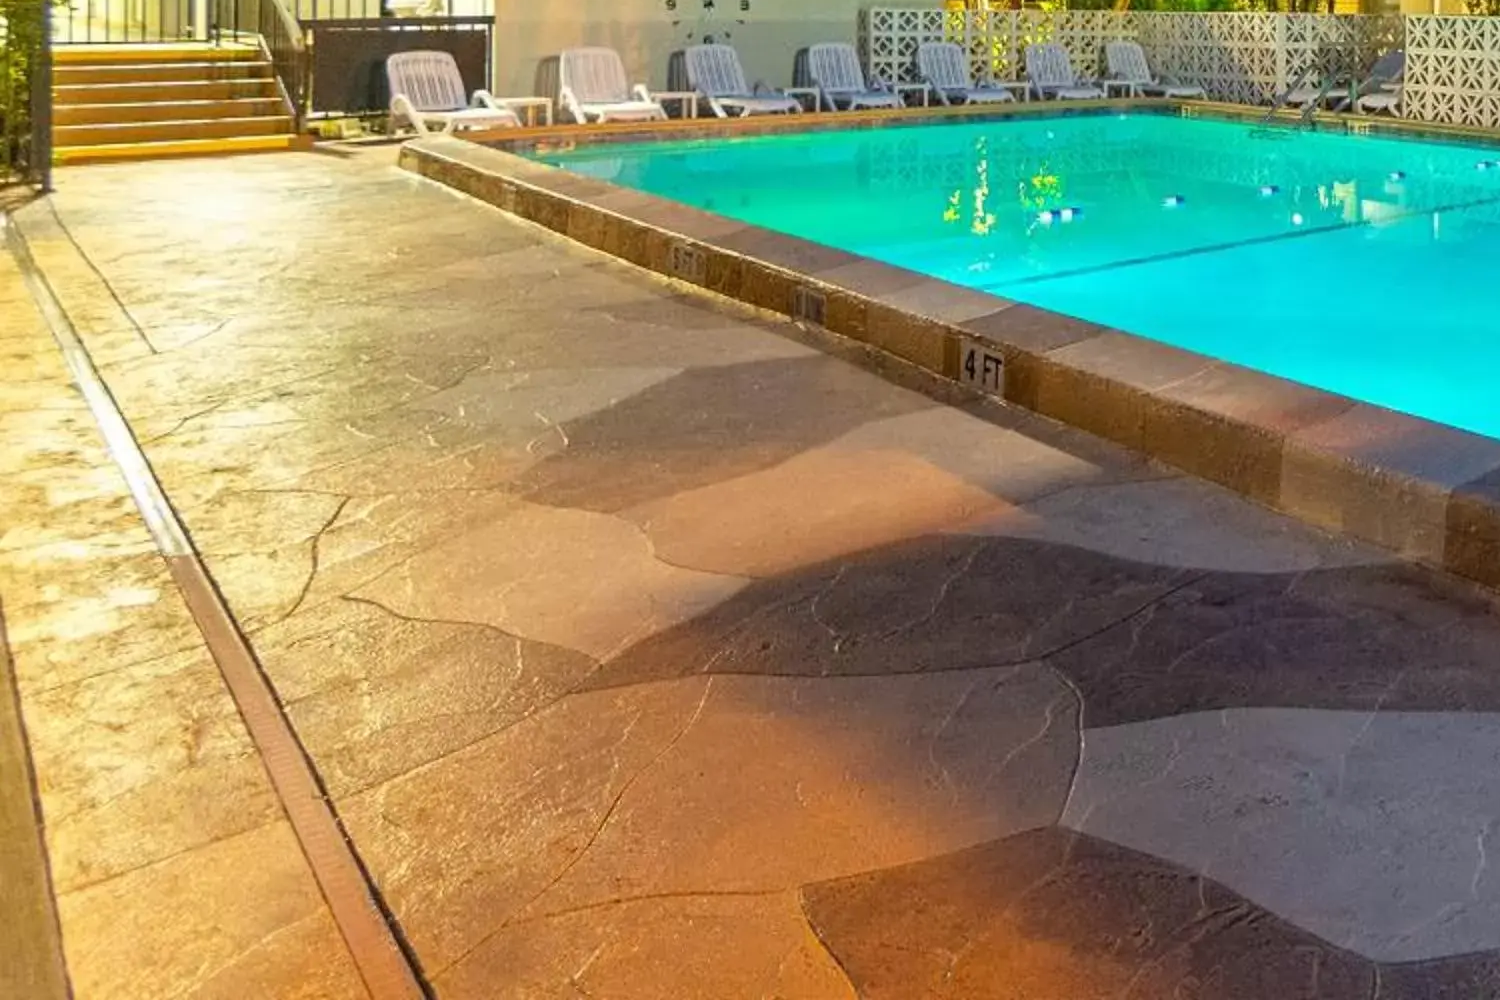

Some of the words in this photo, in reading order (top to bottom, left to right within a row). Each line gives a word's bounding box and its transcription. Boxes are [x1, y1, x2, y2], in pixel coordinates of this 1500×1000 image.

[665, 0, 677, 11] 9
[740, 0, 750, 11] 3
[965, 349, 976, 380] 4
[982, 353, 1003, 390] FT
